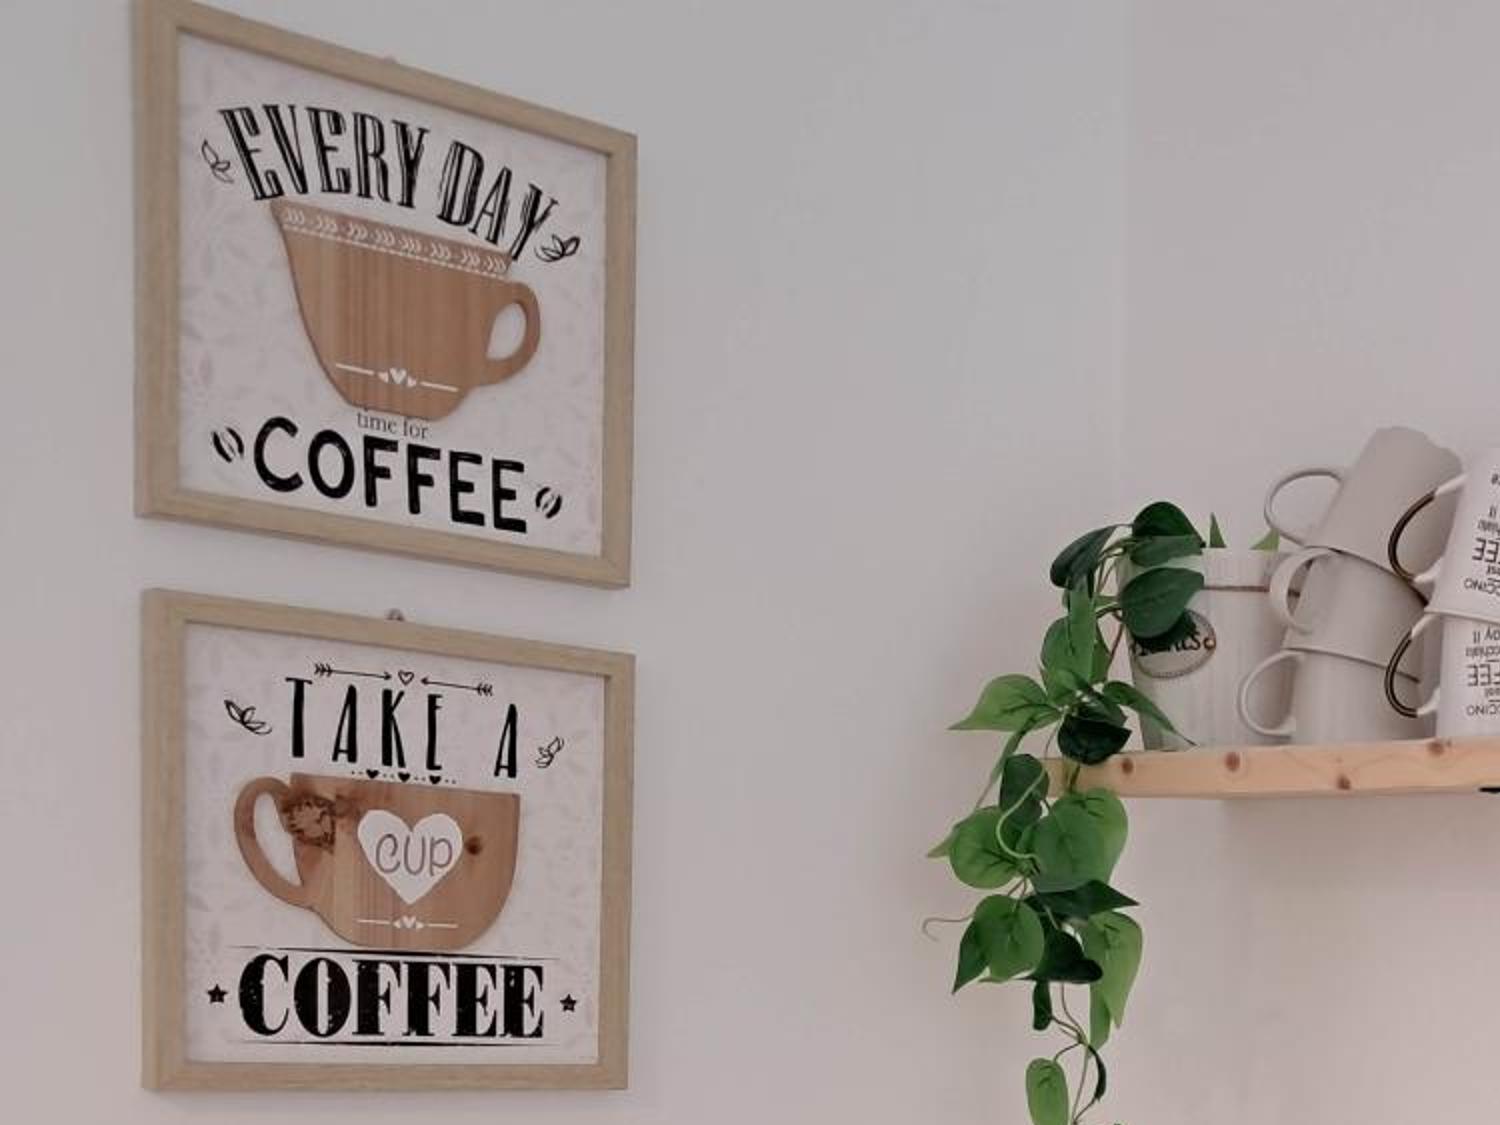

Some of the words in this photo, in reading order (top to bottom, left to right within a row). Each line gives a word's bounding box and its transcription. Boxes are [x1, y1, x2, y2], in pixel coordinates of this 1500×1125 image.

[217, 104, 430, 209] EVERY
[437, 140, 559, 262] DAY
[254, 406, 527, 533] COFFEE
[357, 407, 398, 434] time
[402, 416, 430, 440] for
[285, 677, 443, 771] TAKE
[493, 703, 519, 779] A
[374, 833, 454, 877] CUP
[238, 953, 545, 1039] COFFEE
